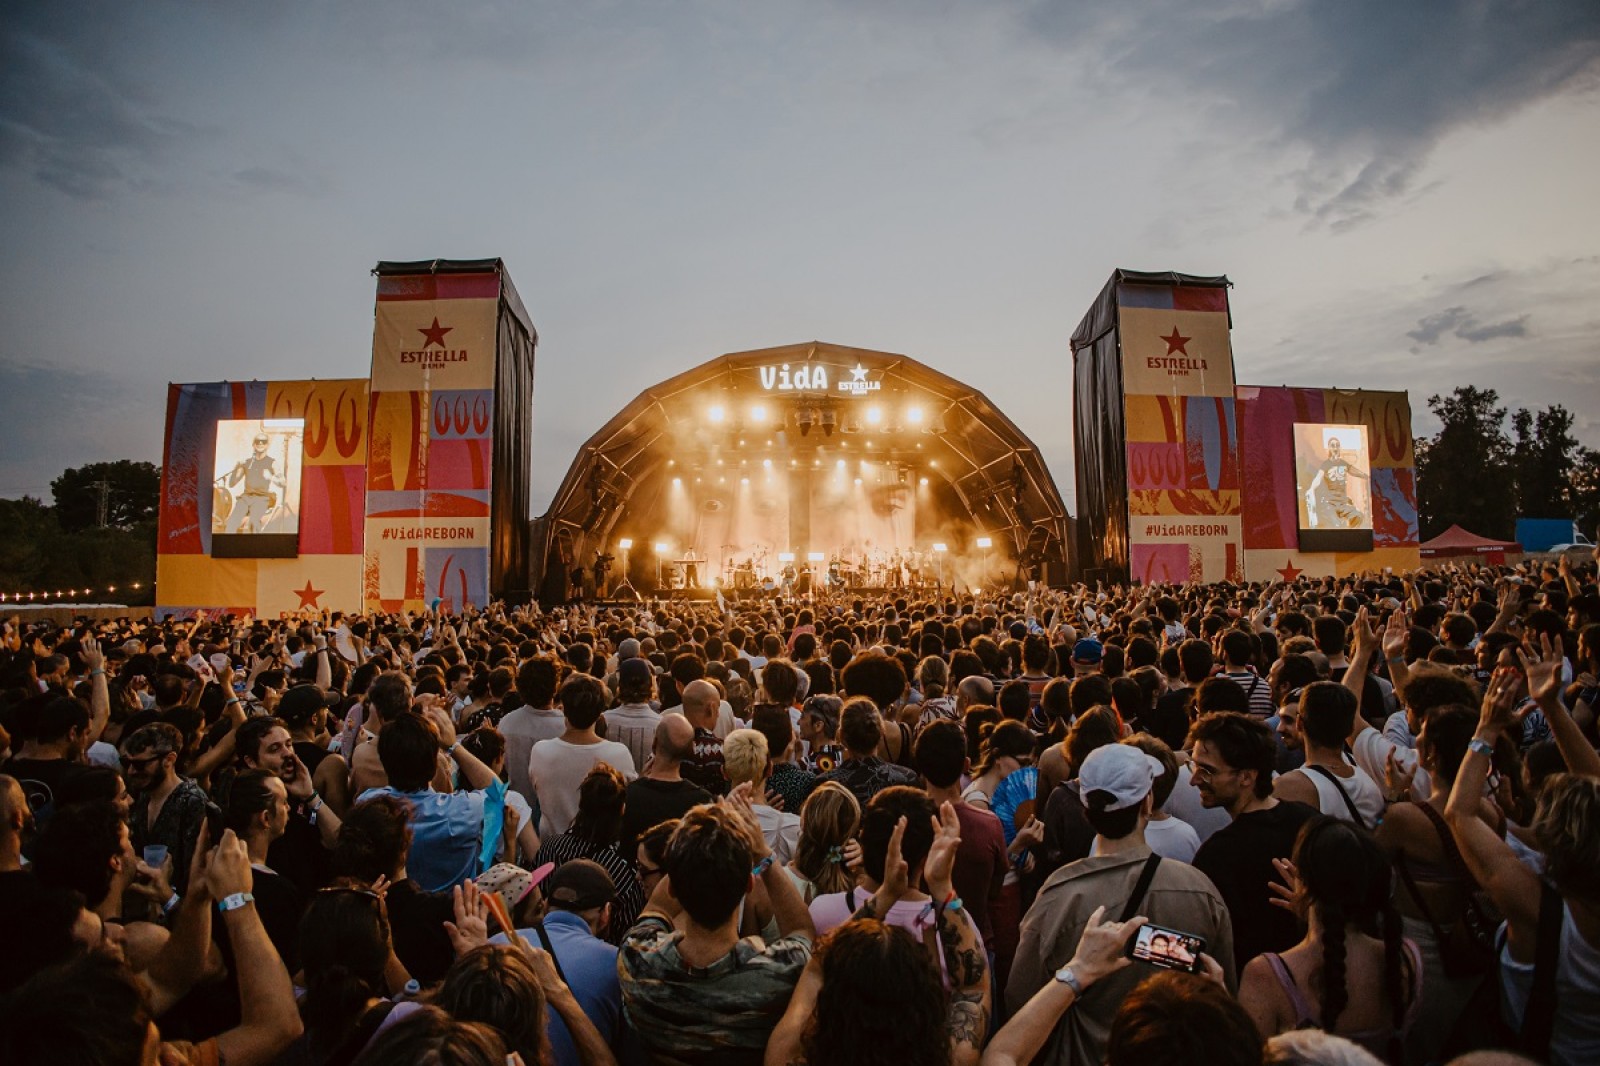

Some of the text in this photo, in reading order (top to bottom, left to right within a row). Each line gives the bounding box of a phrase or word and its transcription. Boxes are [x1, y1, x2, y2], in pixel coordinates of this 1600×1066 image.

[400, 350, 468, 363] ESTRELLA
[1147, 356, 1208, 370] ESTRELLA
[759, 363, 829, 390] VidA
[382, 526, 474, 540] #VidAREBORN
[1145, 523, 1229, 536] #VidAREBORN
